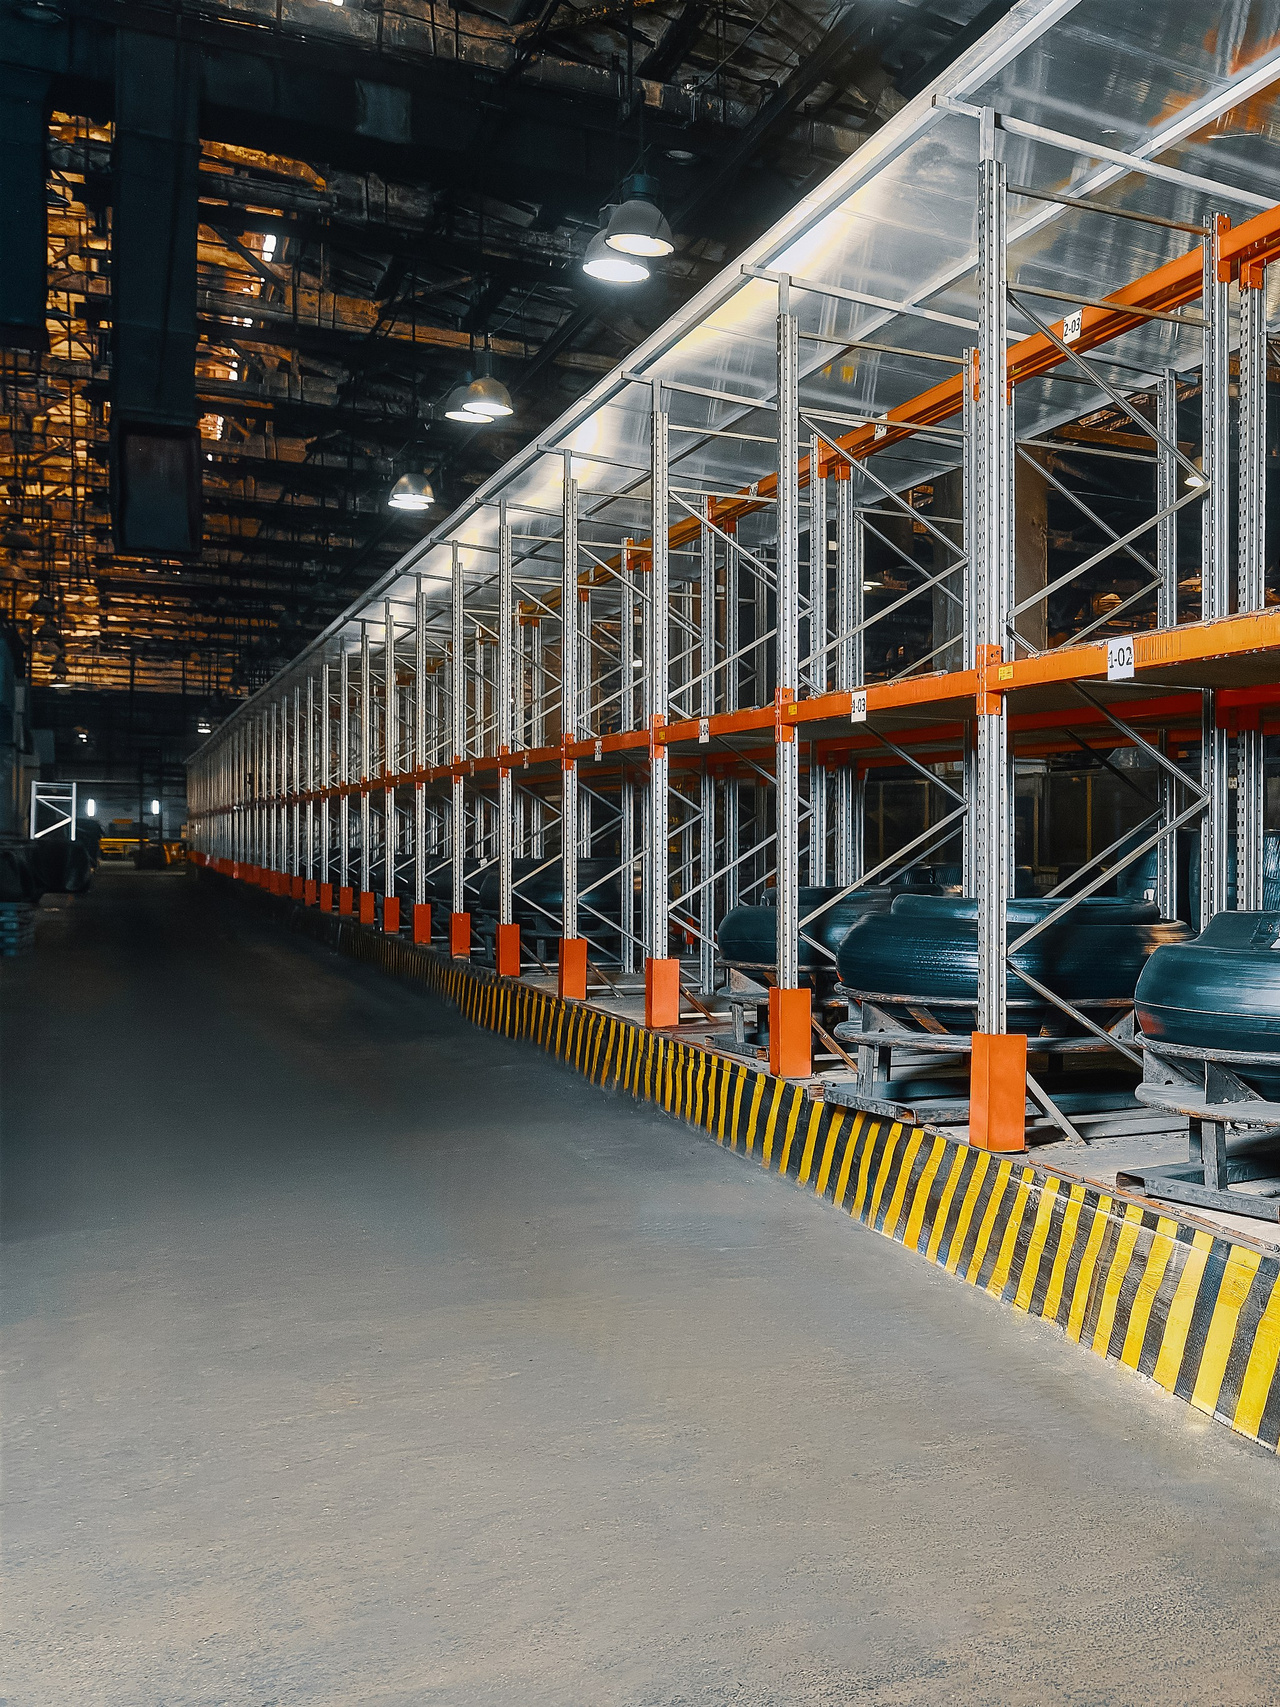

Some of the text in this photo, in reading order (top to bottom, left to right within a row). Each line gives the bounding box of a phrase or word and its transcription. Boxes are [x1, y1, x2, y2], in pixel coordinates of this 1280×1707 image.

[1063, 317, 1081, 337] 2-03
[1109, 646, 1133, 669] 1-02
[852, 697, 866, 713] 1-03
